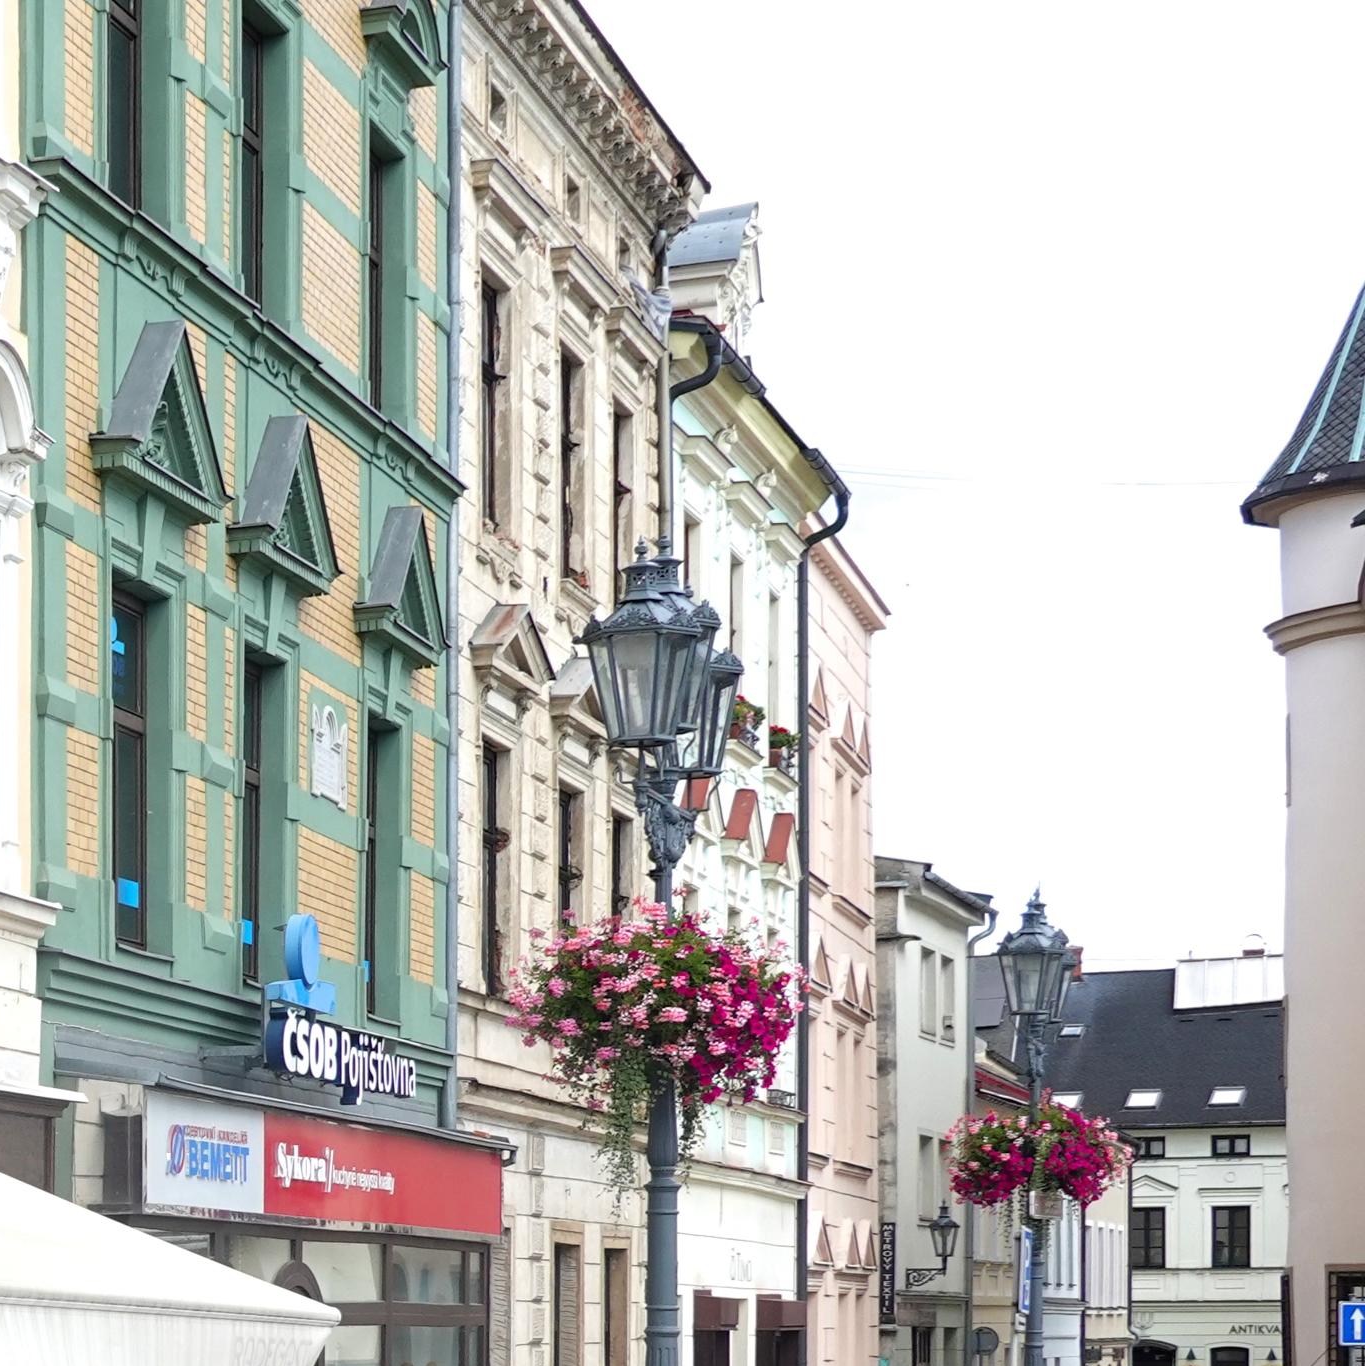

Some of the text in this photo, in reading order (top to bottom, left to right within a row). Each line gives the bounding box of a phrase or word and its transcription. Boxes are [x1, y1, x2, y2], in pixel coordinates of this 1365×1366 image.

[282, 1008, 417, 1105] ČSOB Pojišťovna
[882, 1273, 893, 1313] TEXTIL
